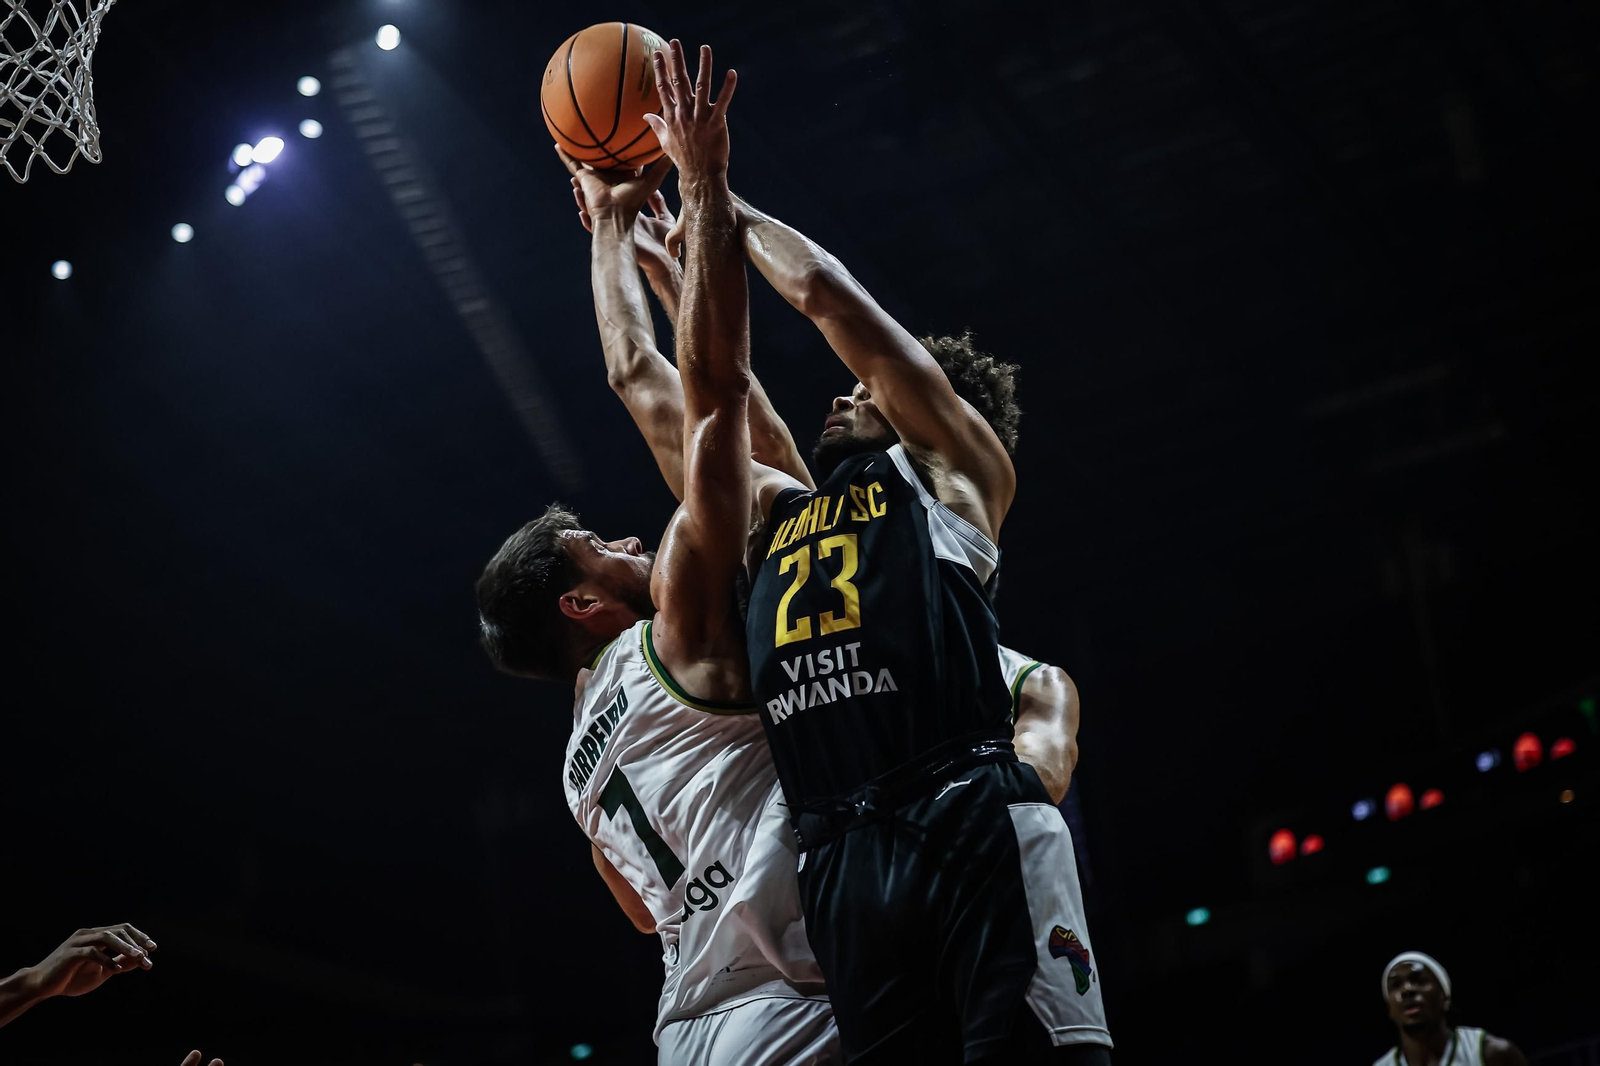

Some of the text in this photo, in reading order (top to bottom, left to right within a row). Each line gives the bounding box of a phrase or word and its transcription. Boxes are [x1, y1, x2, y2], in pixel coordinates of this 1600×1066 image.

[850, 481, 887, 521] SC
[775, 533, 861, 648] 23
[781, 642, 861, 682] VISIT
[766, 668, 898, 725] RWANDA
